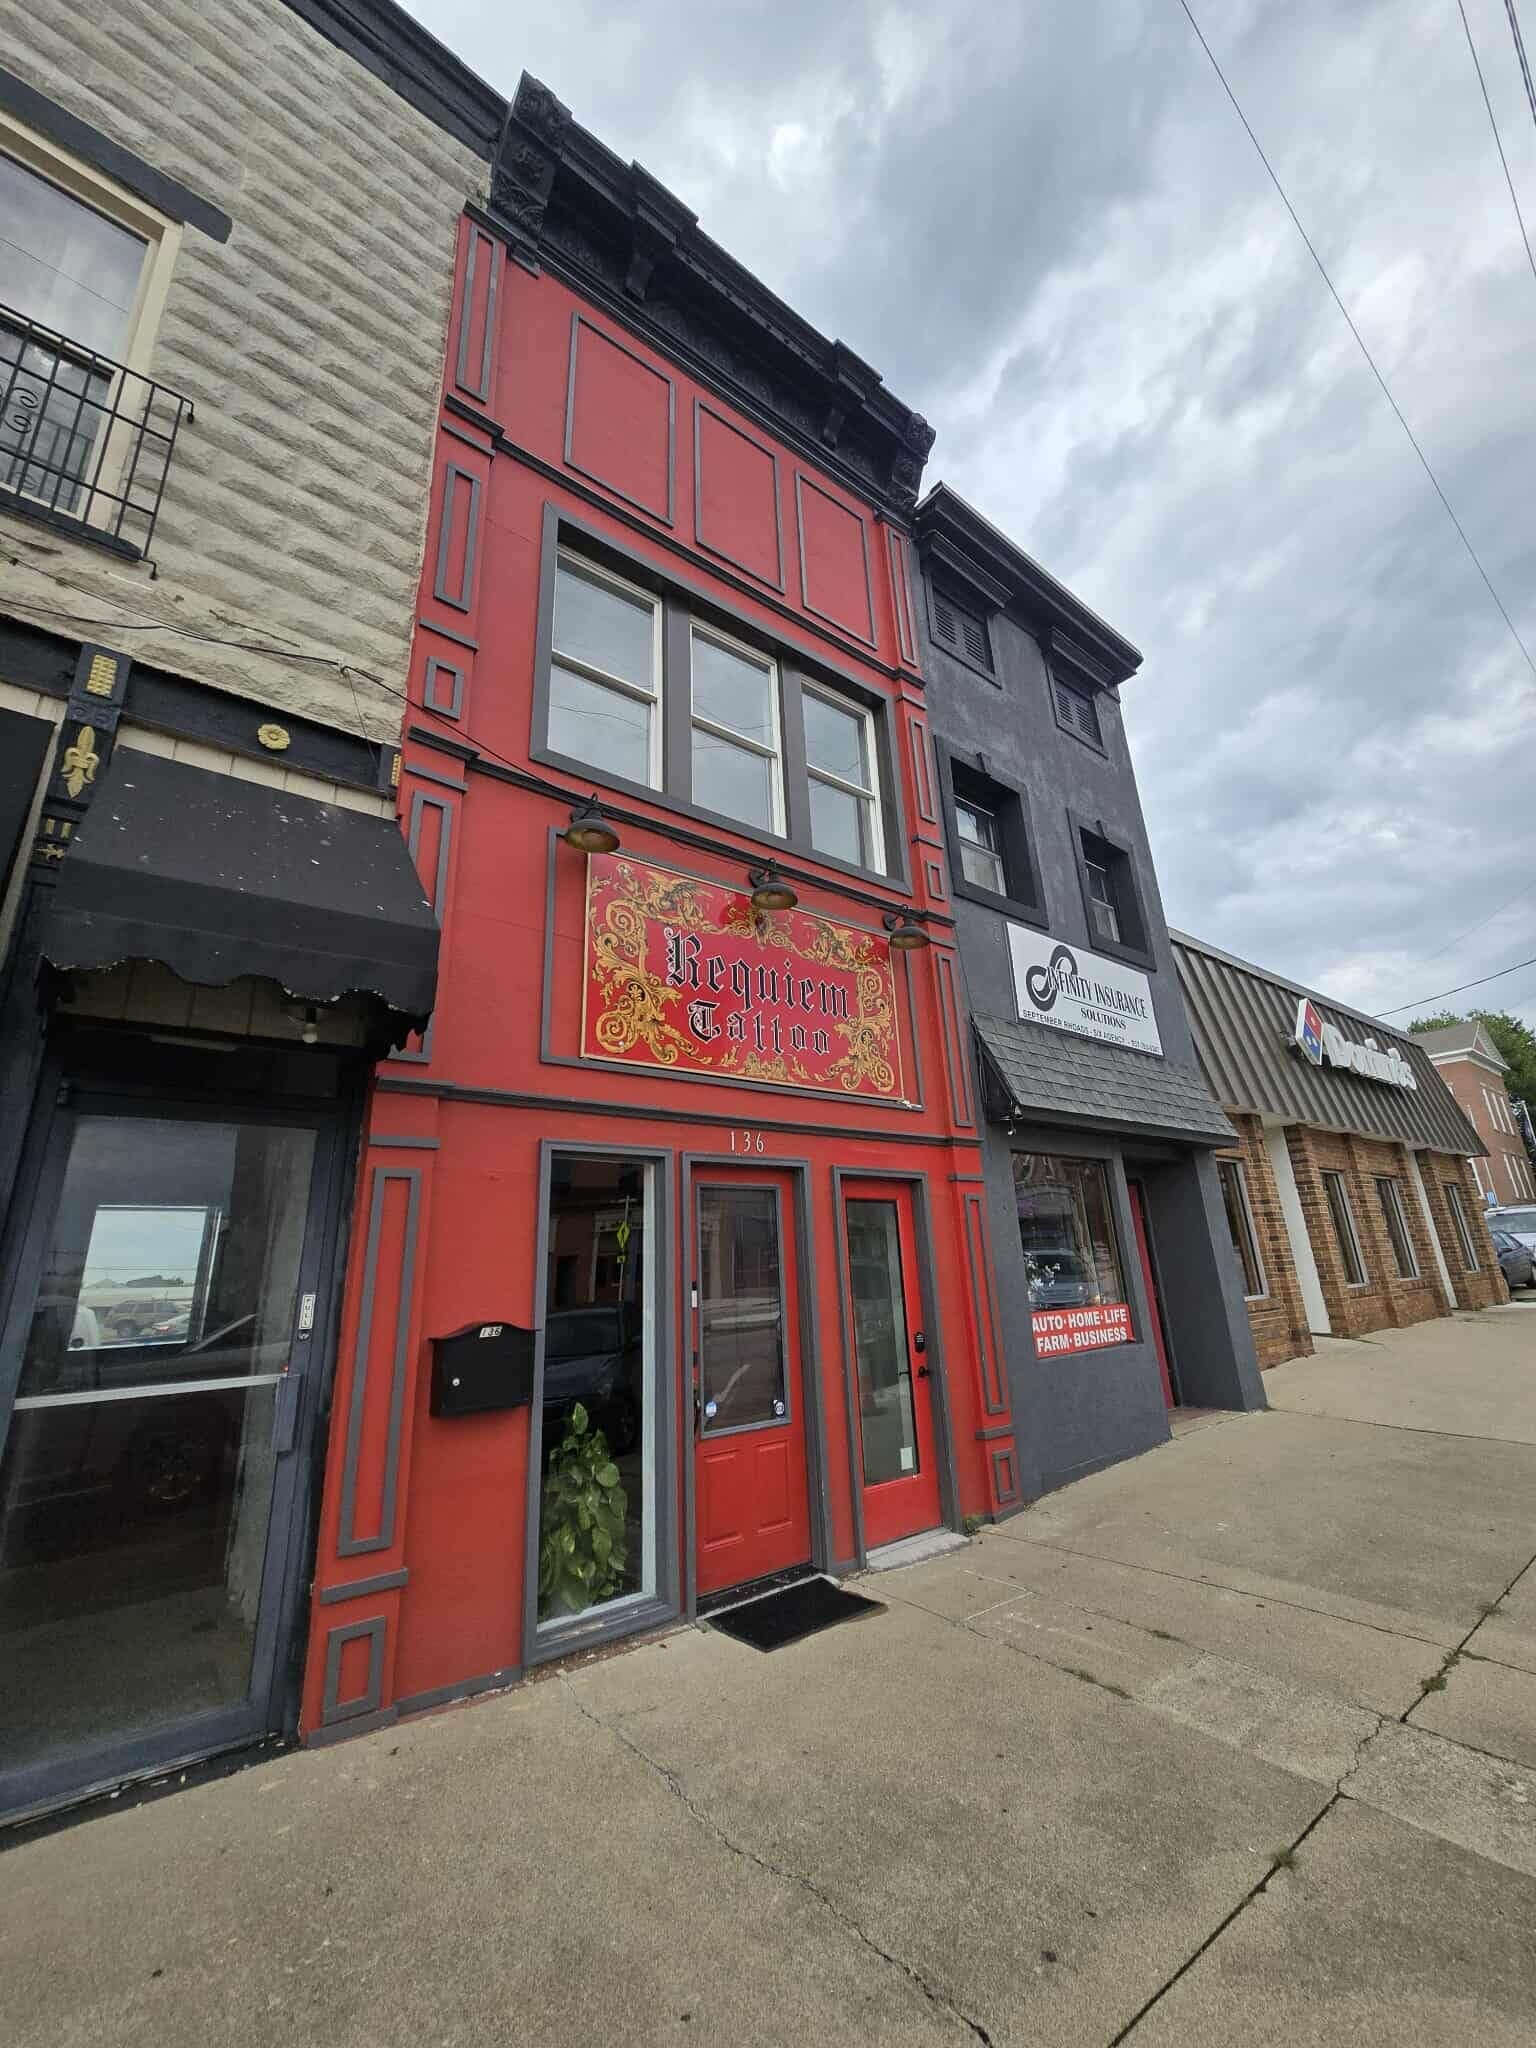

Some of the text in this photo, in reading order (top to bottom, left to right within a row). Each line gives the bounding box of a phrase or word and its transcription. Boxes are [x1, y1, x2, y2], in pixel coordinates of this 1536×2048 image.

[664, 927, 851, 1019] Requiem
[1046, 966, 1149, 1019] INFINITY INSURANCE
[688, 999, 830, 1056] Tattoo
[1080, 1007, 1127, 1031] SOLUTIONS
[730, 1131, 764, 1153] 136
[481, 1327, 502, 1337] 136
